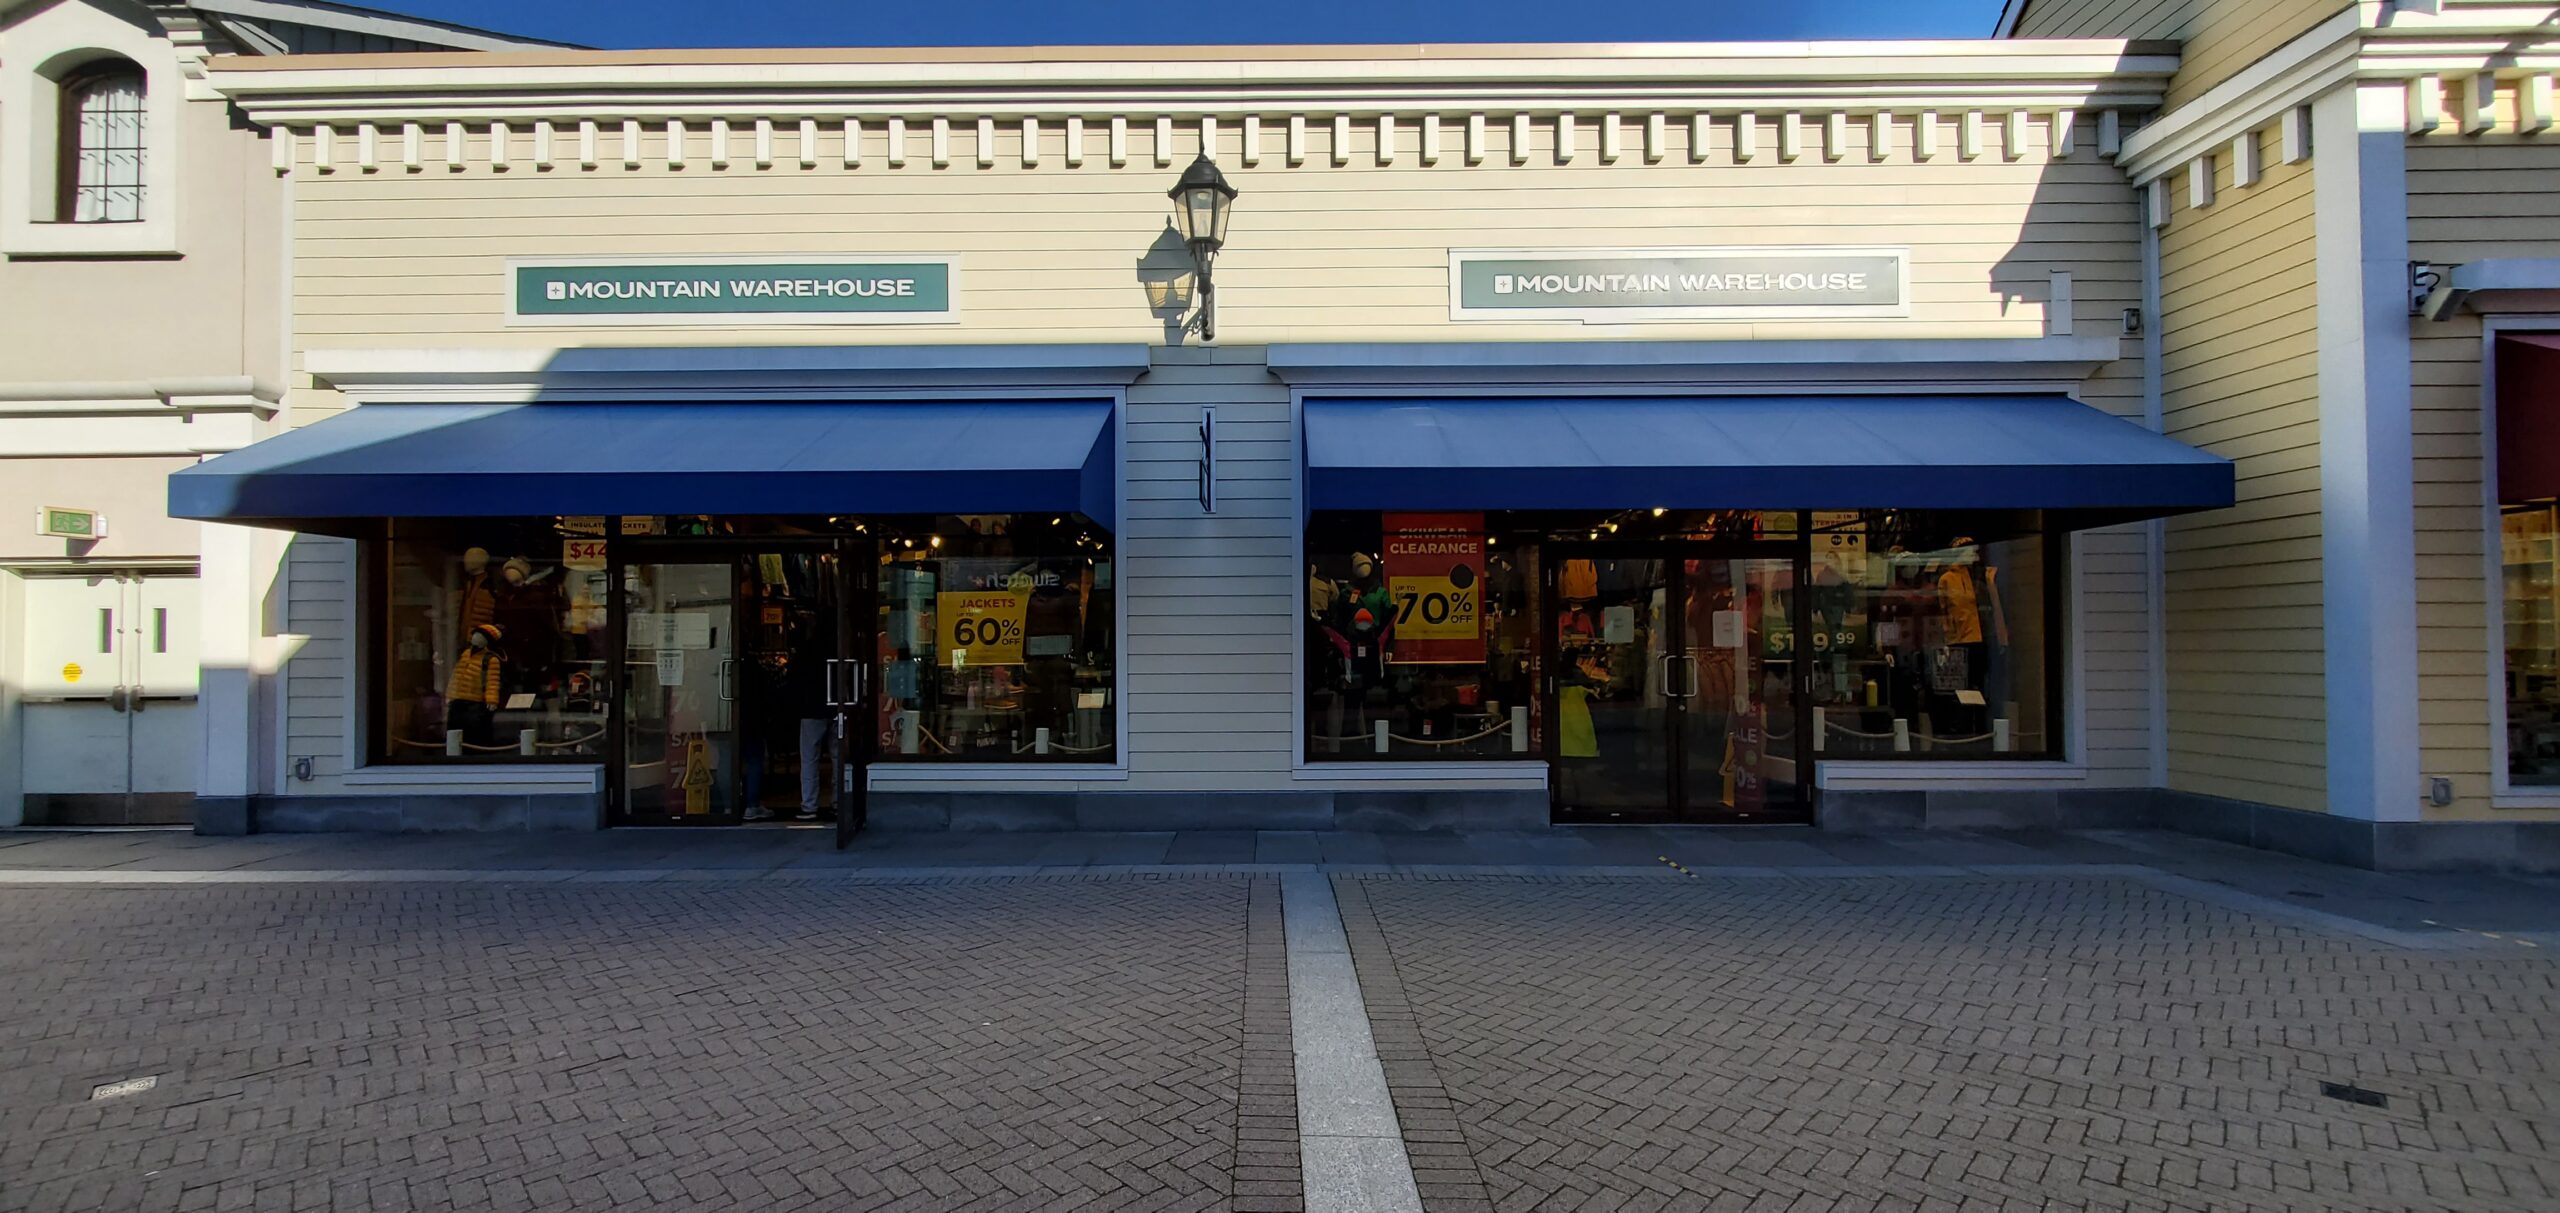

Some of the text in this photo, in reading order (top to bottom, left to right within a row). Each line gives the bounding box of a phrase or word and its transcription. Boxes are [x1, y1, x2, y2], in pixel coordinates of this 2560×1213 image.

[569, 278, 916, 299] MOUNTAIN WAREHOUSE
[1517, 272, 1868, 294] MOUNTAIN WAREHOUSE
[1399, 527, 1468, 539] SKIWEAR
[1389, 542, 1478, 555] CLEARANCE
[960, 598, 1016, 608] JACKETS
[1396, 592, 1473, 625] 70%
[1451, 615, 1473, 624] OFF
[954, 617, 1020, 646] 60%
[1001, 638, 1021, 646] OFF
